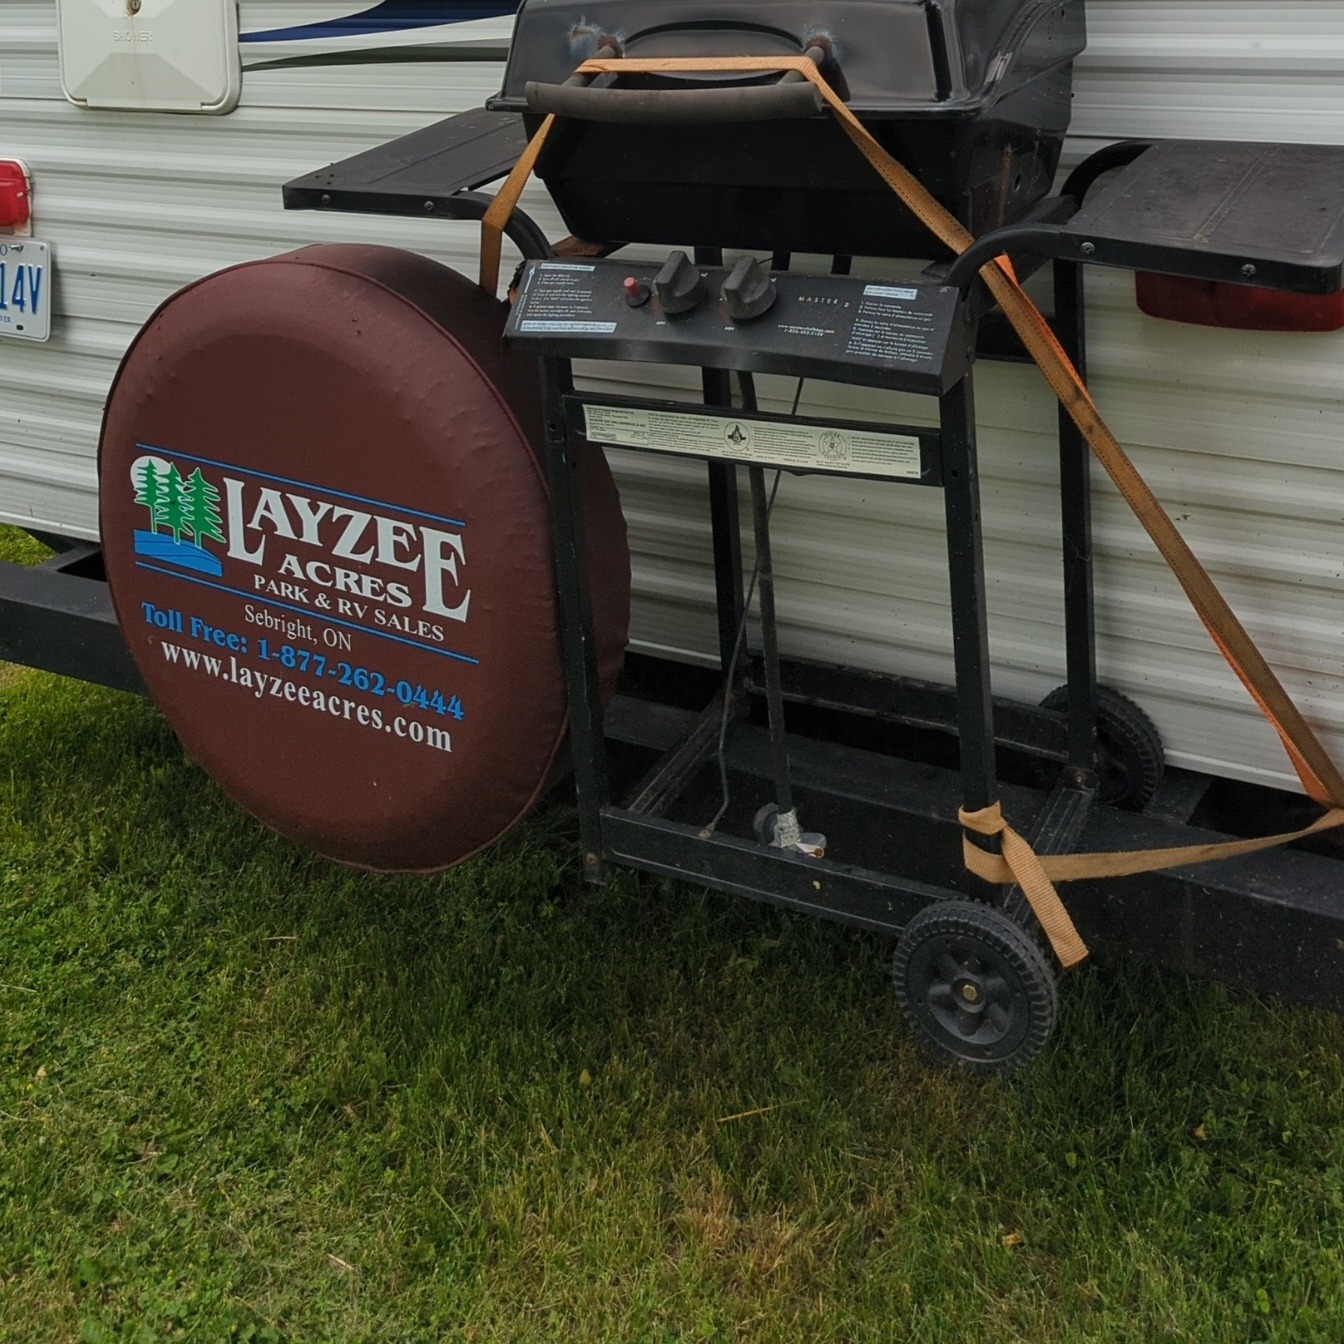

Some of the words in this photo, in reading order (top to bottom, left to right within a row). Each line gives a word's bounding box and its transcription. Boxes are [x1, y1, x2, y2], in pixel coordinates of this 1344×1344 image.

[113, 30, 153, 42] SHOWER
[798, 296, 838, 305] MASTER
[223, 477, 471, 623] LAYZEE
[253, 574, 310, 604] PARK
[314, 592, 331, 610] &
[338, 598, 369, 619] RV
[374, 609, 445, 642] SALES
[277, 554, 413, 608] ACRES
[244, 604, 318, 645] Sebright,
[323, 627, 353, 652] ON
[141, 601, 184, 633] Toll
[190, 616, 248, 654] Free:
[257, 638, 465, 721] 1-877-262-0444
[161, 641, 454, 754] www.layzeeacres.com
